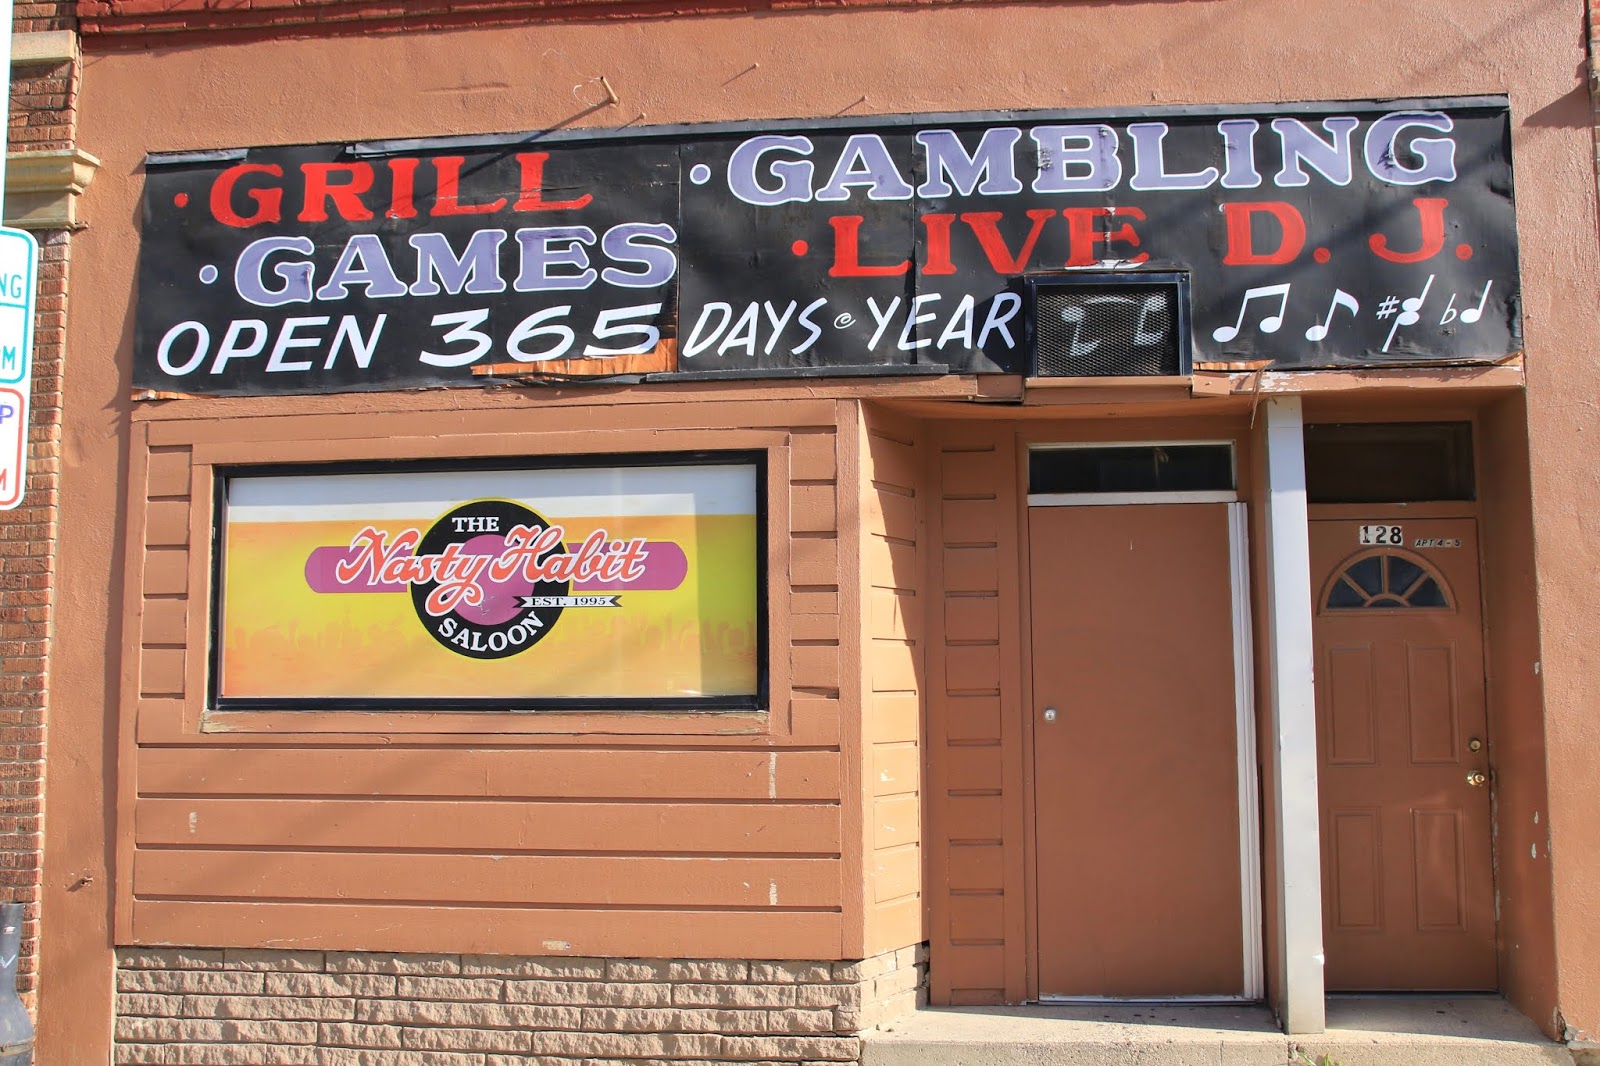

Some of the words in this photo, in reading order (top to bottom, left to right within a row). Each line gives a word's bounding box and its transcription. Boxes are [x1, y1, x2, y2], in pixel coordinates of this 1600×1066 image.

[209, 152, 593, 227] GRILL
[727, 111, 1457, 206] GAMBLING
[234, 222, 677, 307] GAMES
[828, 206, 1149, 277] LIVE
[157, 313, 387, 376] OPEN
[418, 303, 662, 368] 365
[682, 297, 827, 358] DAYS
[866, 292, 1022, 351] YEAR
[451, 516, 499, 533] THE
[1362, 526, 1402, 544] 128
[1415, 539, 1434, 547] APT
[335, 526, 493, 617] Nasty
[488, 524, 649, 584] Habit
[531, 597, 567, 606] EST.
[572, 597, 606, 606] 1995
[437, 611, 544, 653] SALOON
